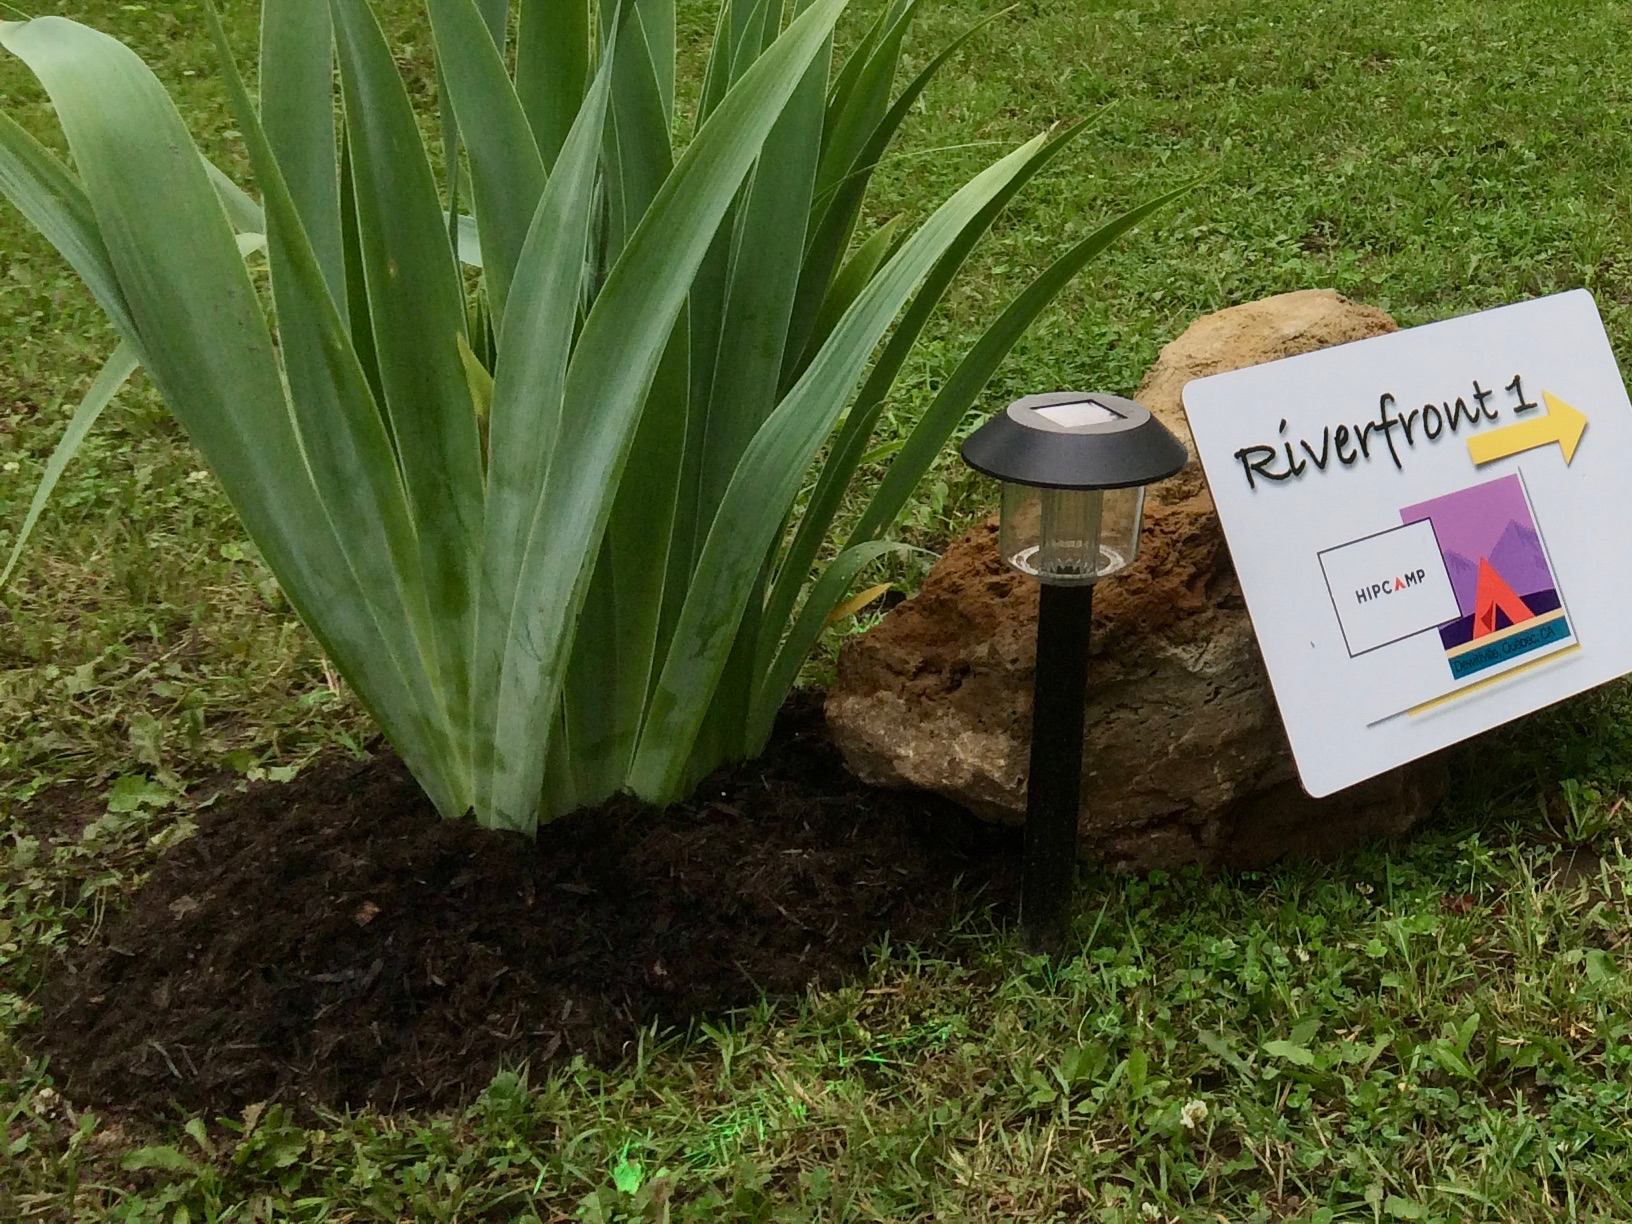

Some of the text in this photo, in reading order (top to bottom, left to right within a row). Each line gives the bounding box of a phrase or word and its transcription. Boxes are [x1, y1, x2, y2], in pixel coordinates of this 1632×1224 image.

[1234, 374, 1538, 489] Riverfront 1
[1355, 568, 1426, 604] HIPCAMP
[1540, 625, 1556, 641] CA
